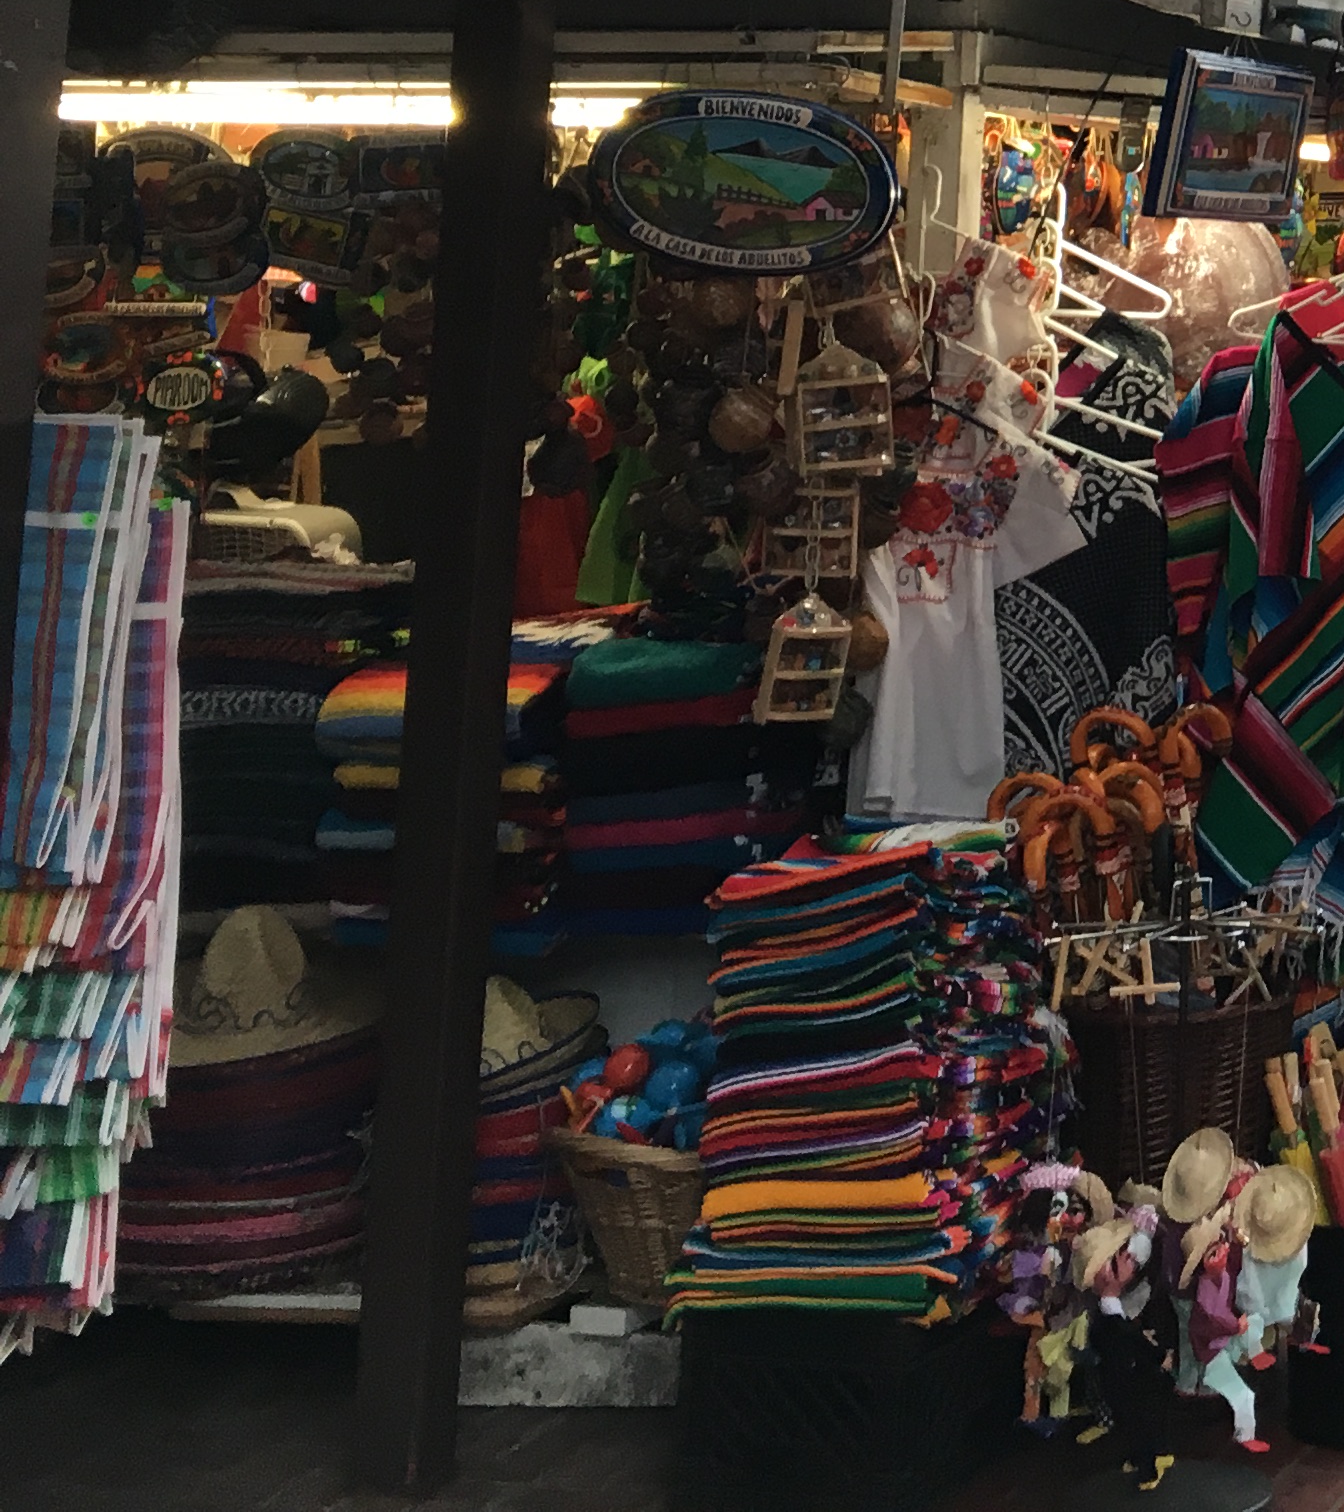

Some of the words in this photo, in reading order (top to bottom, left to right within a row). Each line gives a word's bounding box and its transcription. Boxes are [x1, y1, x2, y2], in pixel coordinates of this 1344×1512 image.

[703, 99, 803, 125] BIENVENIDOS
[633, 224, 643, 237] A
[644, 228, 661, 245] LA
[665, 238, 697, 256] CASA
[712, 250, 735, 264] LOS
[737, 249, 805, 266] ABUELITOS
